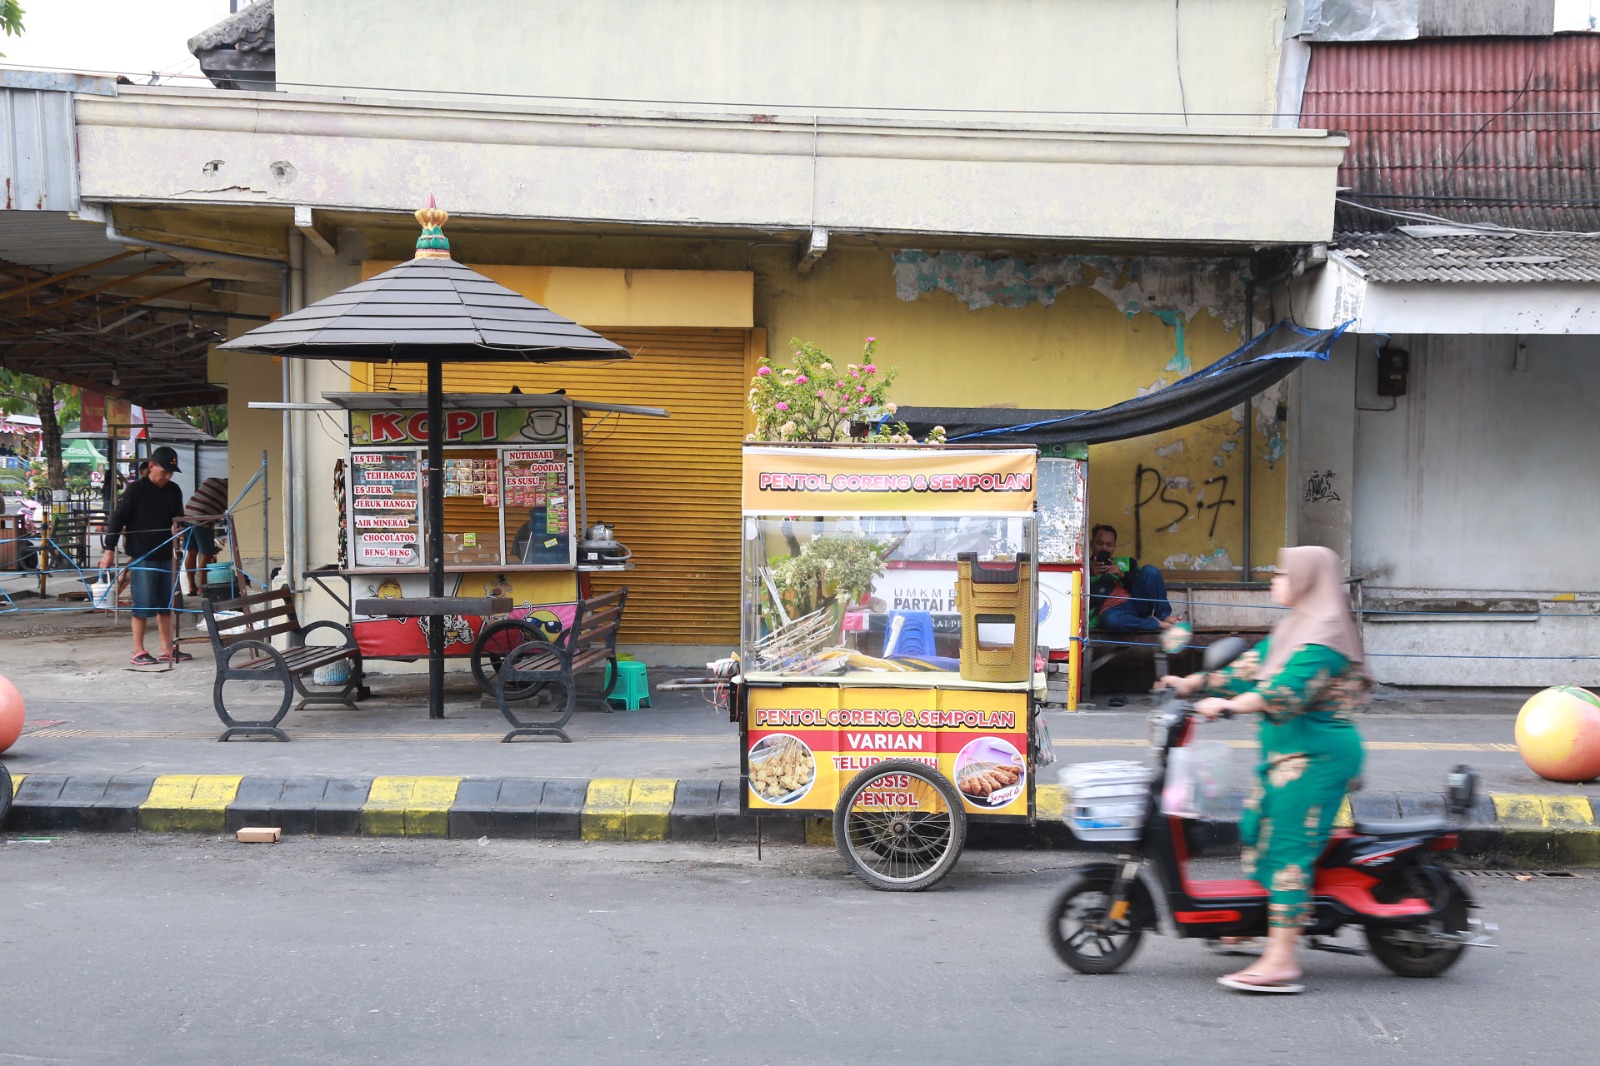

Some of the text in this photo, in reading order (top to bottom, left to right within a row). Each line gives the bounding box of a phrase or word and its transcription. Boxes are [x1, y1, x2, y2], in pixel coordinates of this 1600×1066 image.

[370, 410, 497, 442] KOPI
[354, 455, 382, 463] ES TEH
[509, 451, 553, 460] NUTRISARI
[531, 464, 565, 472] GOODAY
[366, 472, 416, 480] TEH HANGAT
[507, 477, 539, 486] ES SUSU
[759, 472, 1032, 492] PENTOL GORENG & SEMPOLAN
[355, 486, 393, 494] ES JERUK
[355, 500, 417, 508] JERUK HANGAT
[357, 519, 408, 527] AIR MINERAL
[363, 534, 415, 542] CHOCOLATOS
[364, 548, 386, 556] BENG
[894, 588, 942, 598] UMKM
[893, 598, 943, 611] PARTAI
[757, 710, 1015, 728] PENTOL GORENG & SEMPOLAN
[847, 733, 923, 750] VARIAN
[868, 775, 909, 788] OSIS
[856, 793, 919, 806] PENTOL
